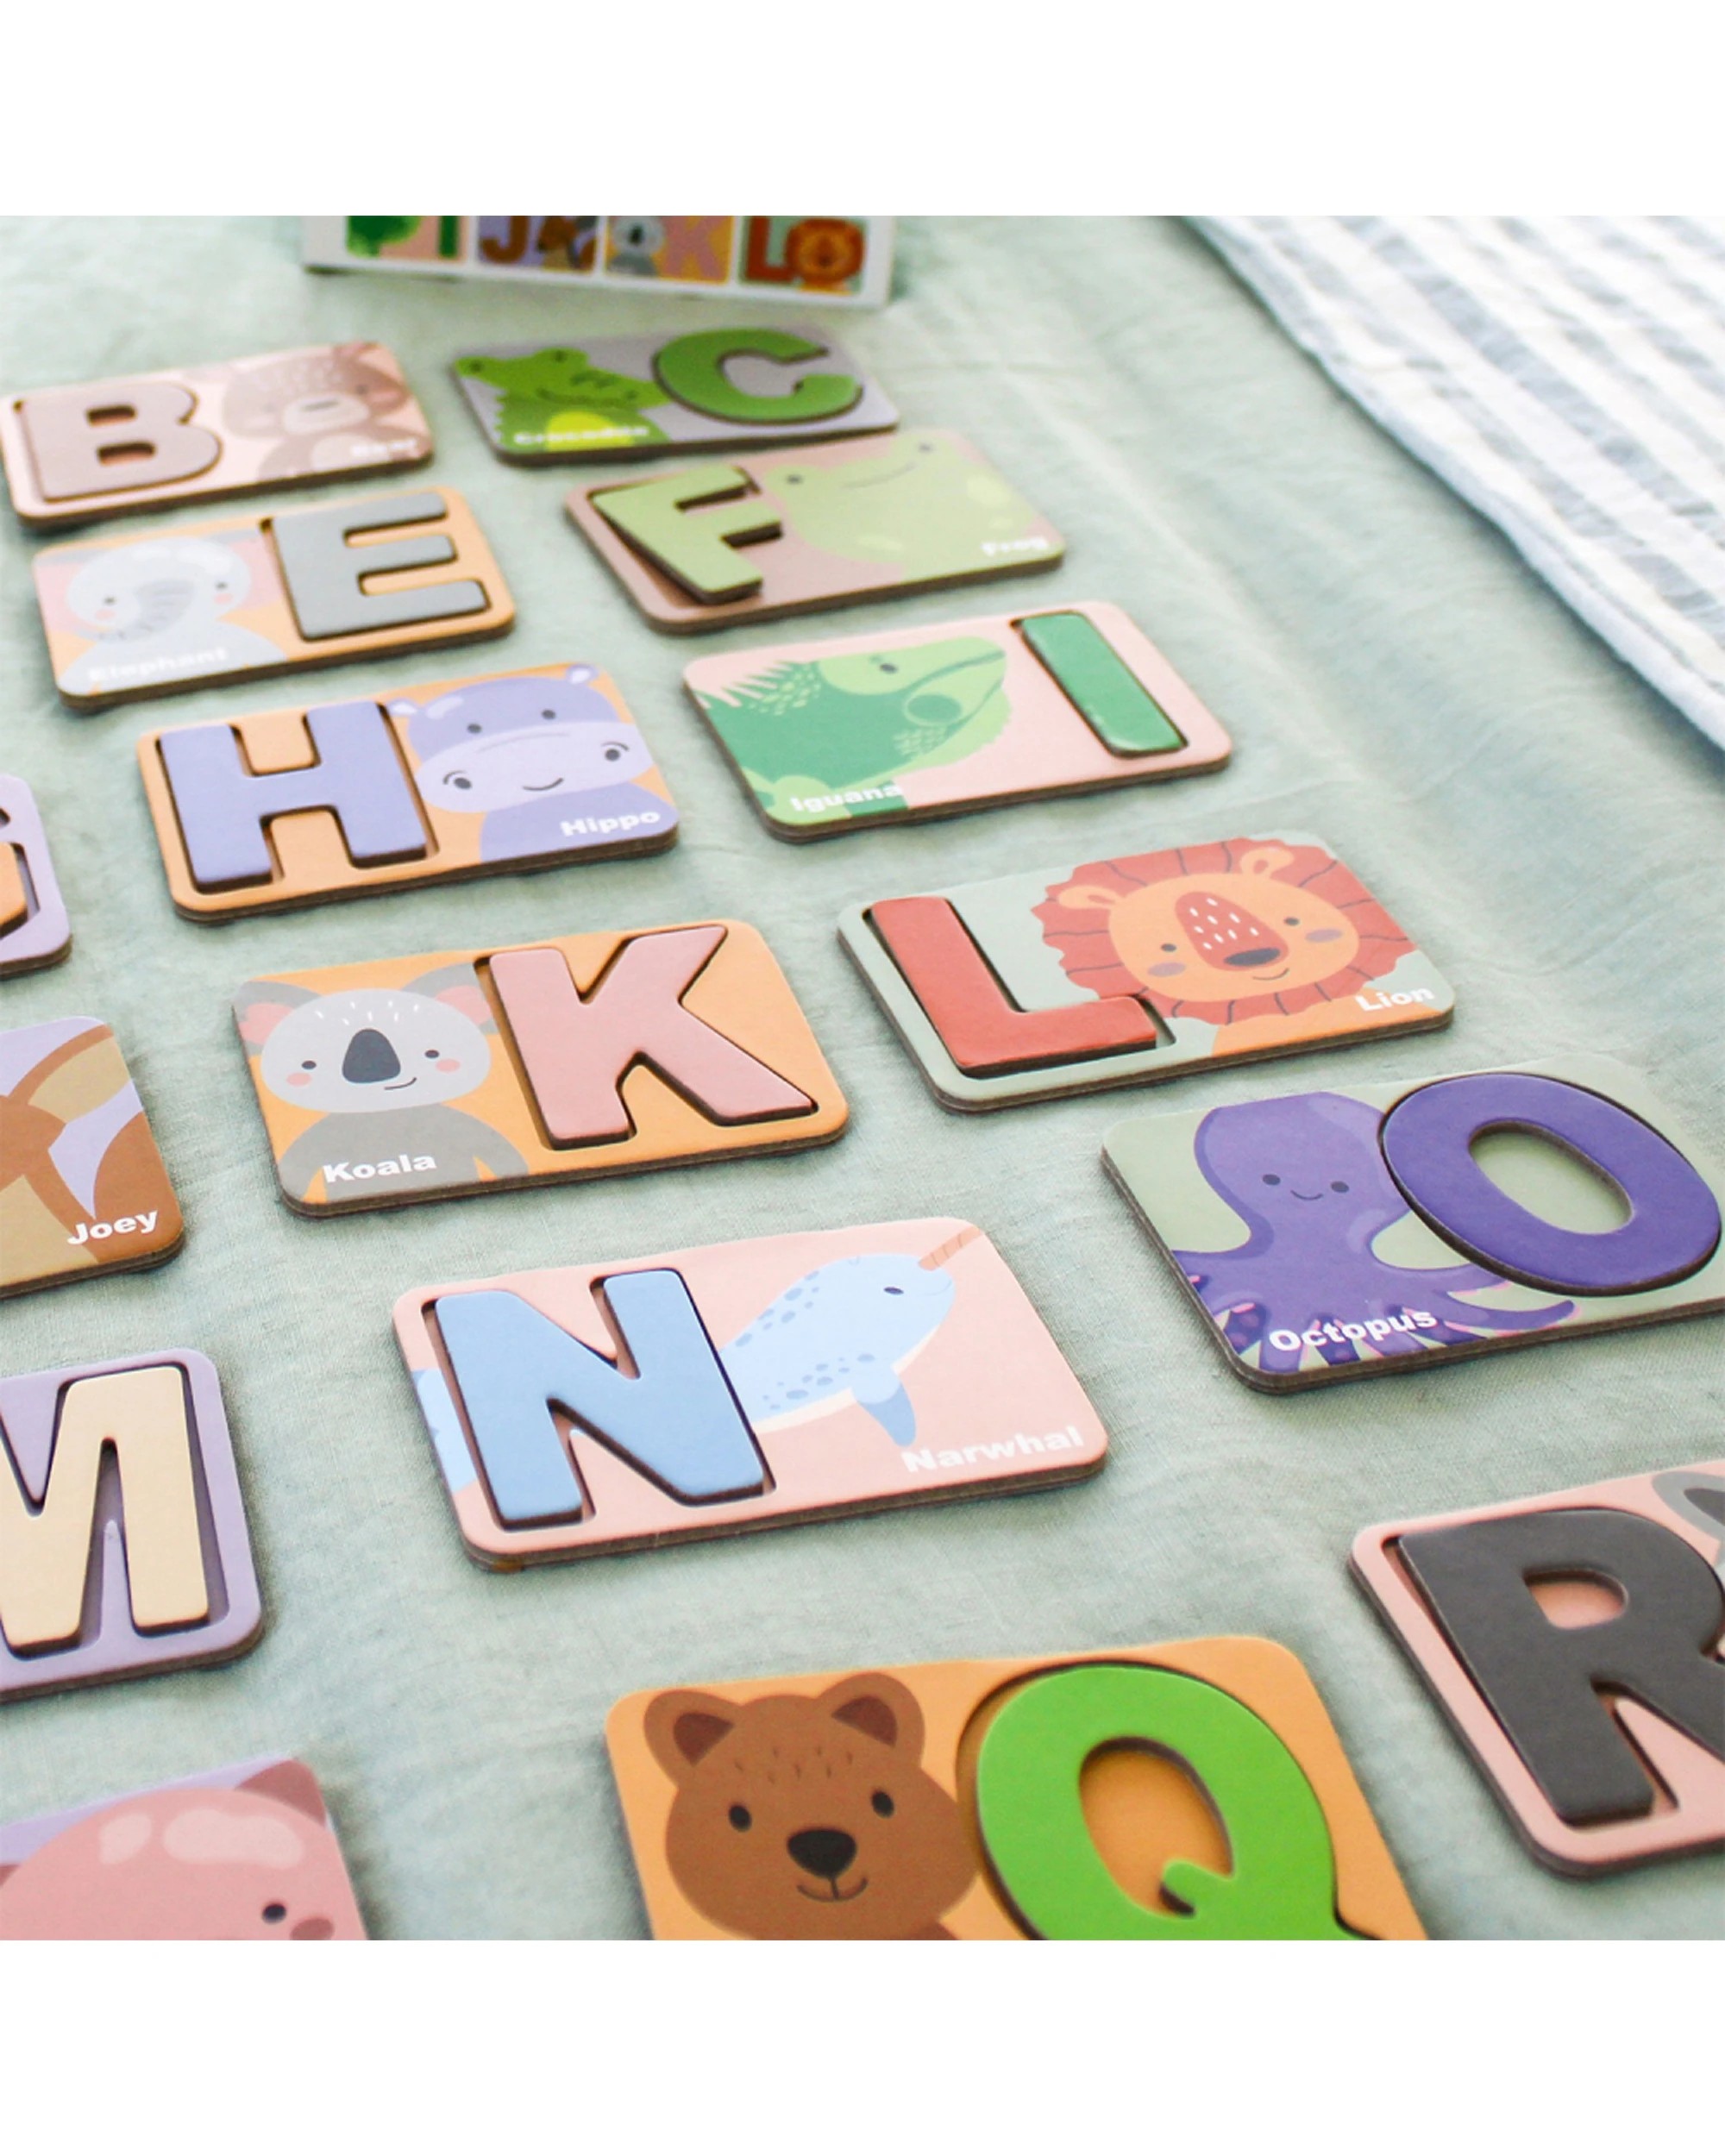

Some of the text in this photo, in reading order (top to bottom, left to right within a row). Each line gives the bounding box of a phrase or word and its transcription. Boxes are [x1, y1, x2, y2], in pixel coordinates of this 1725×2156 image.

[22, 381, 222, 503] B
[656, 327, 861, 423] C
[272, 492, 491, 642] E
[592, 463, 782, 601] F
[1021, 611, 1188, 756] I
[159, 700, 428, 893] H
[561, 811, 661, 837] Hippo
[789, 783, 904, 813] Iguana
[487, 925, 818, 1150] K
[869, 895, 1159, 1075] L
[1355, 987, 1435, 1012] Lion
[67, 1210, 158, 1244] Joey
[322, 1153, 438, 1184] Koala
[1378, 1072, 1722, 1296] O
[435, 1268, 768, 1529] N
[1268, 1311, 1438, 1351] Octopus
[901, 1425, 1084, 1473] Narwhal
[1397, 1507, 1725, 1827] R
[976, 1664, 1367, 1940] Q
